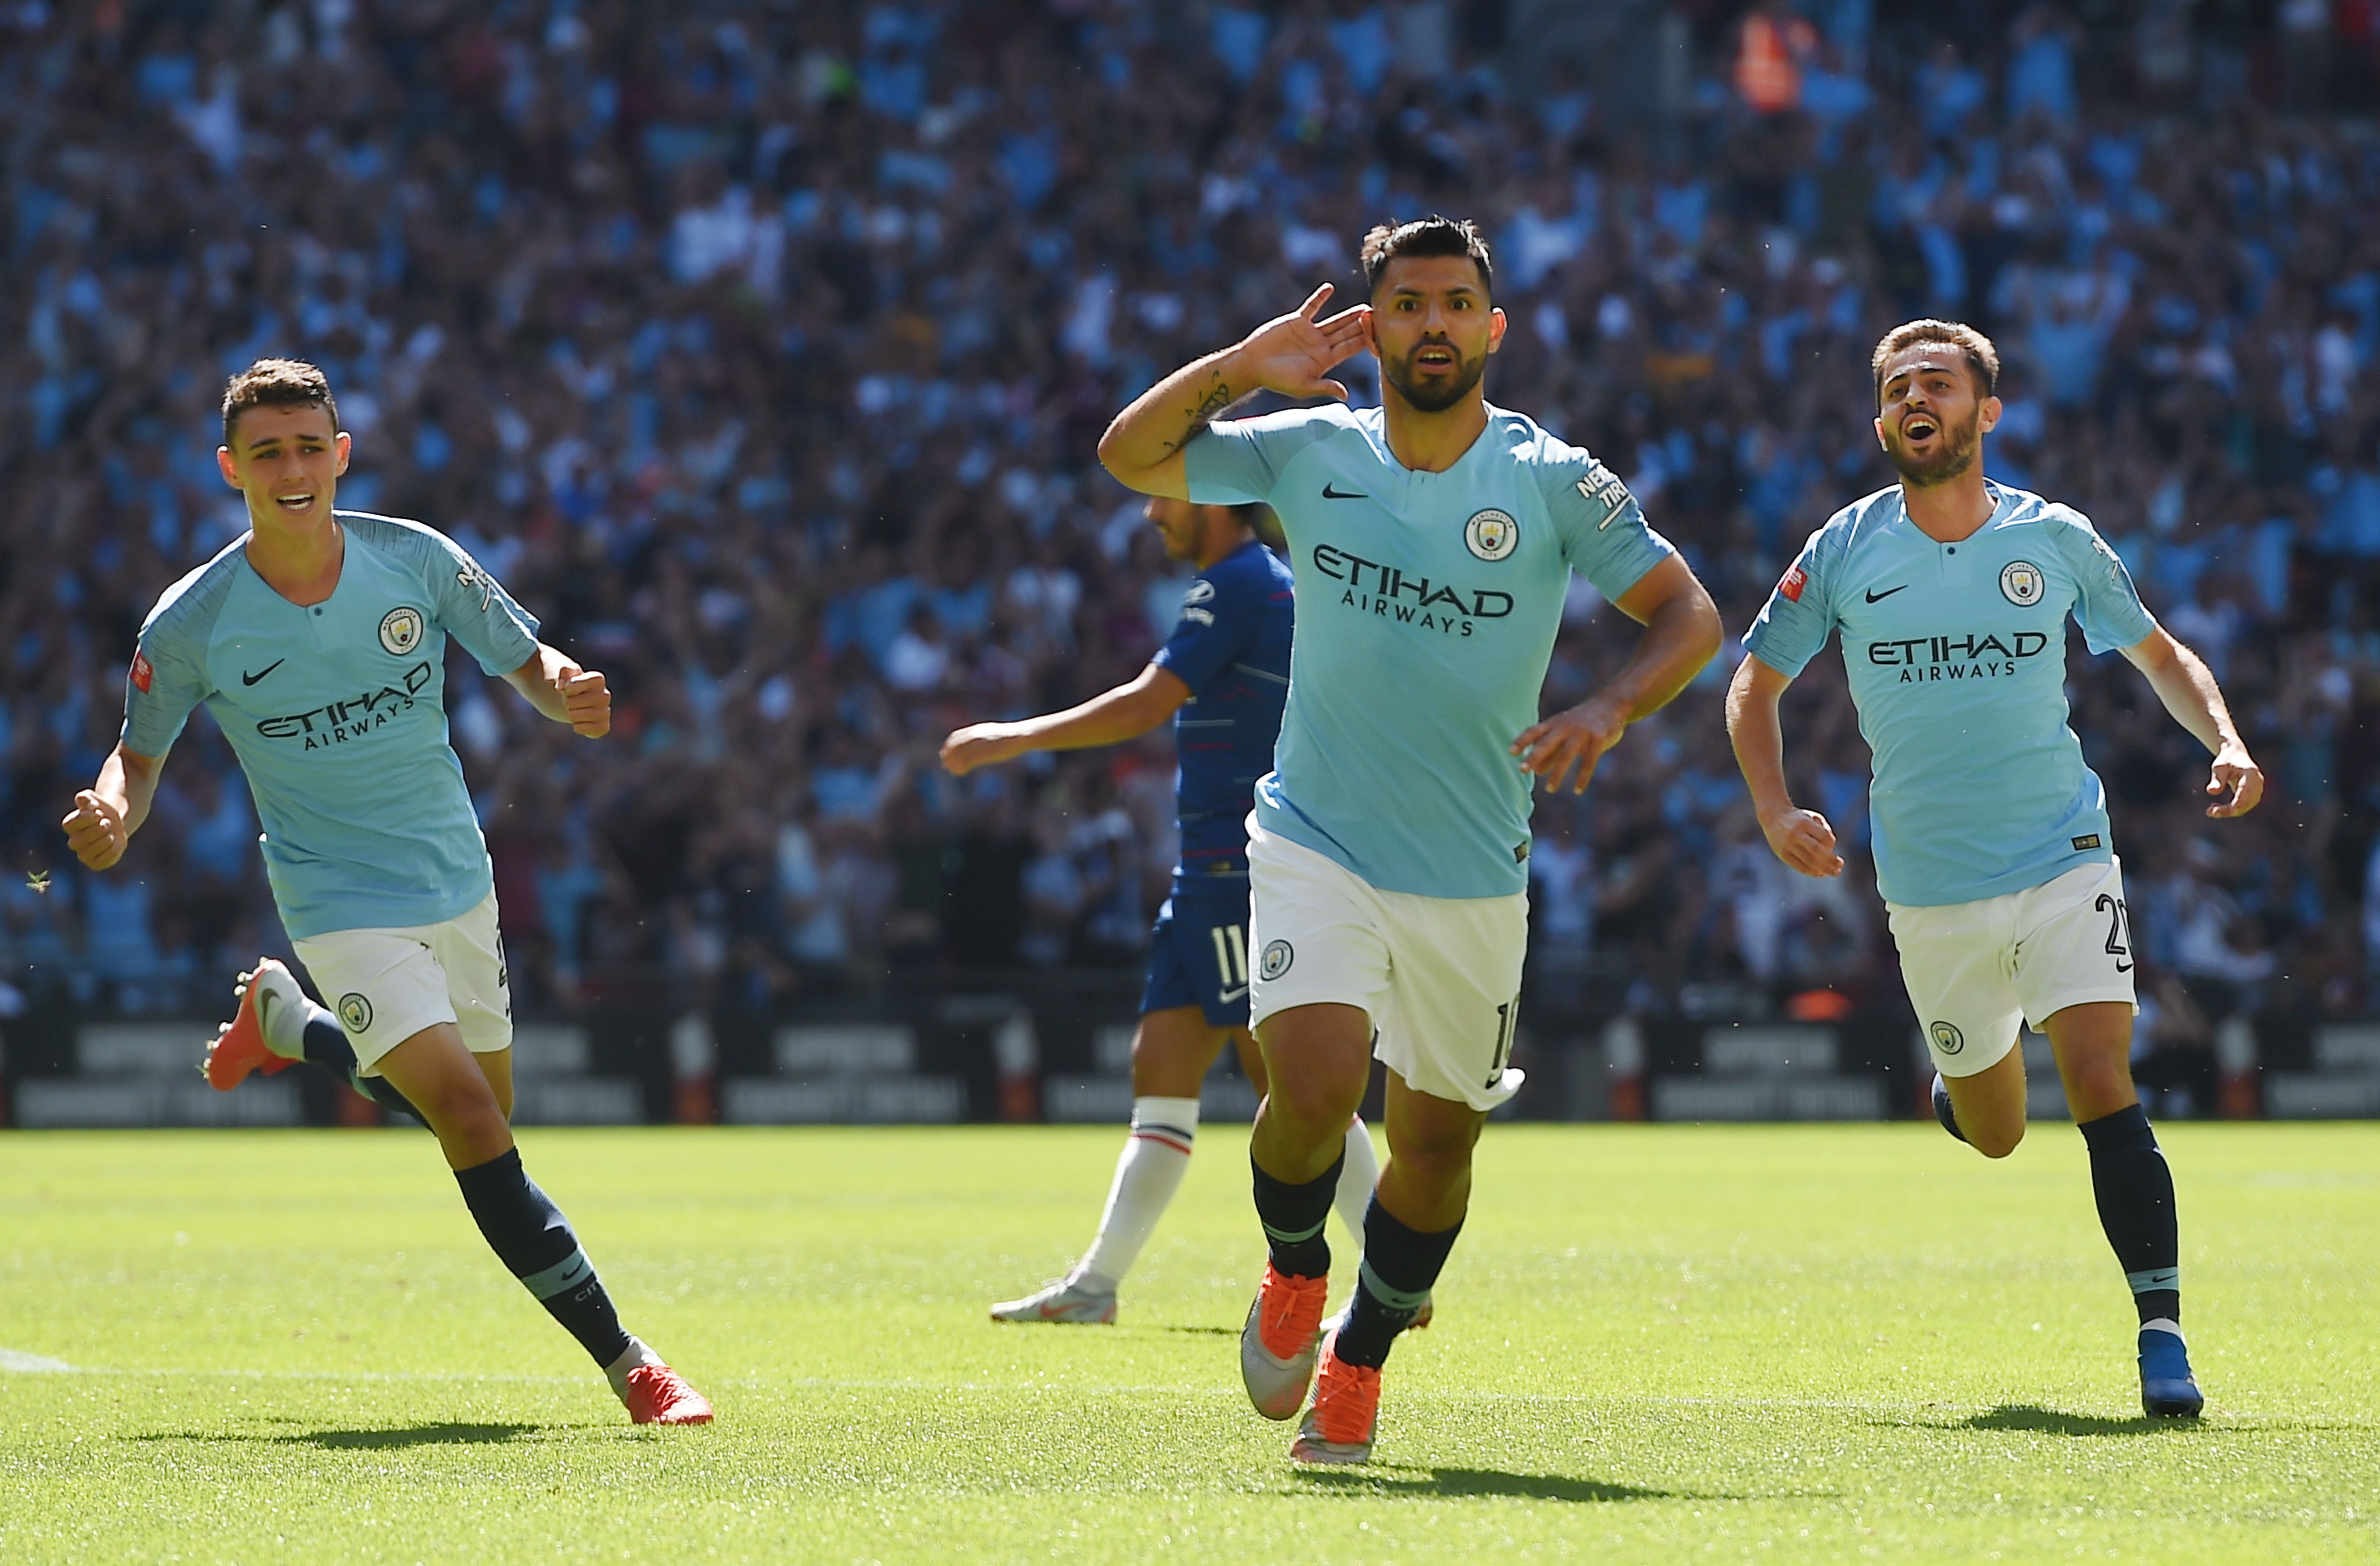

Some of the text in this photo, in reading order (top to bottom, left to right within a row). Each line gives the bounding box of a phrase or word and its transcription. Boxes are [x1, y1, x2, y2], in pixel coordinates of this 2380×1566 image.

[1313, 543, 1514, 618] ETIHAD
[1341, 588, 1474, 637] AIRWAYS
[1869, 632, 2048, 665] ETIHAD
[1900, 661, 2016, 683] AIRWAYS
[256, 660, 431, 738] ETIHAD
[304, 695, 415, 751] AIRWAYS
[1211, 923, 1248, 987] 11
[575, 1280, 598, 1302] CIT
